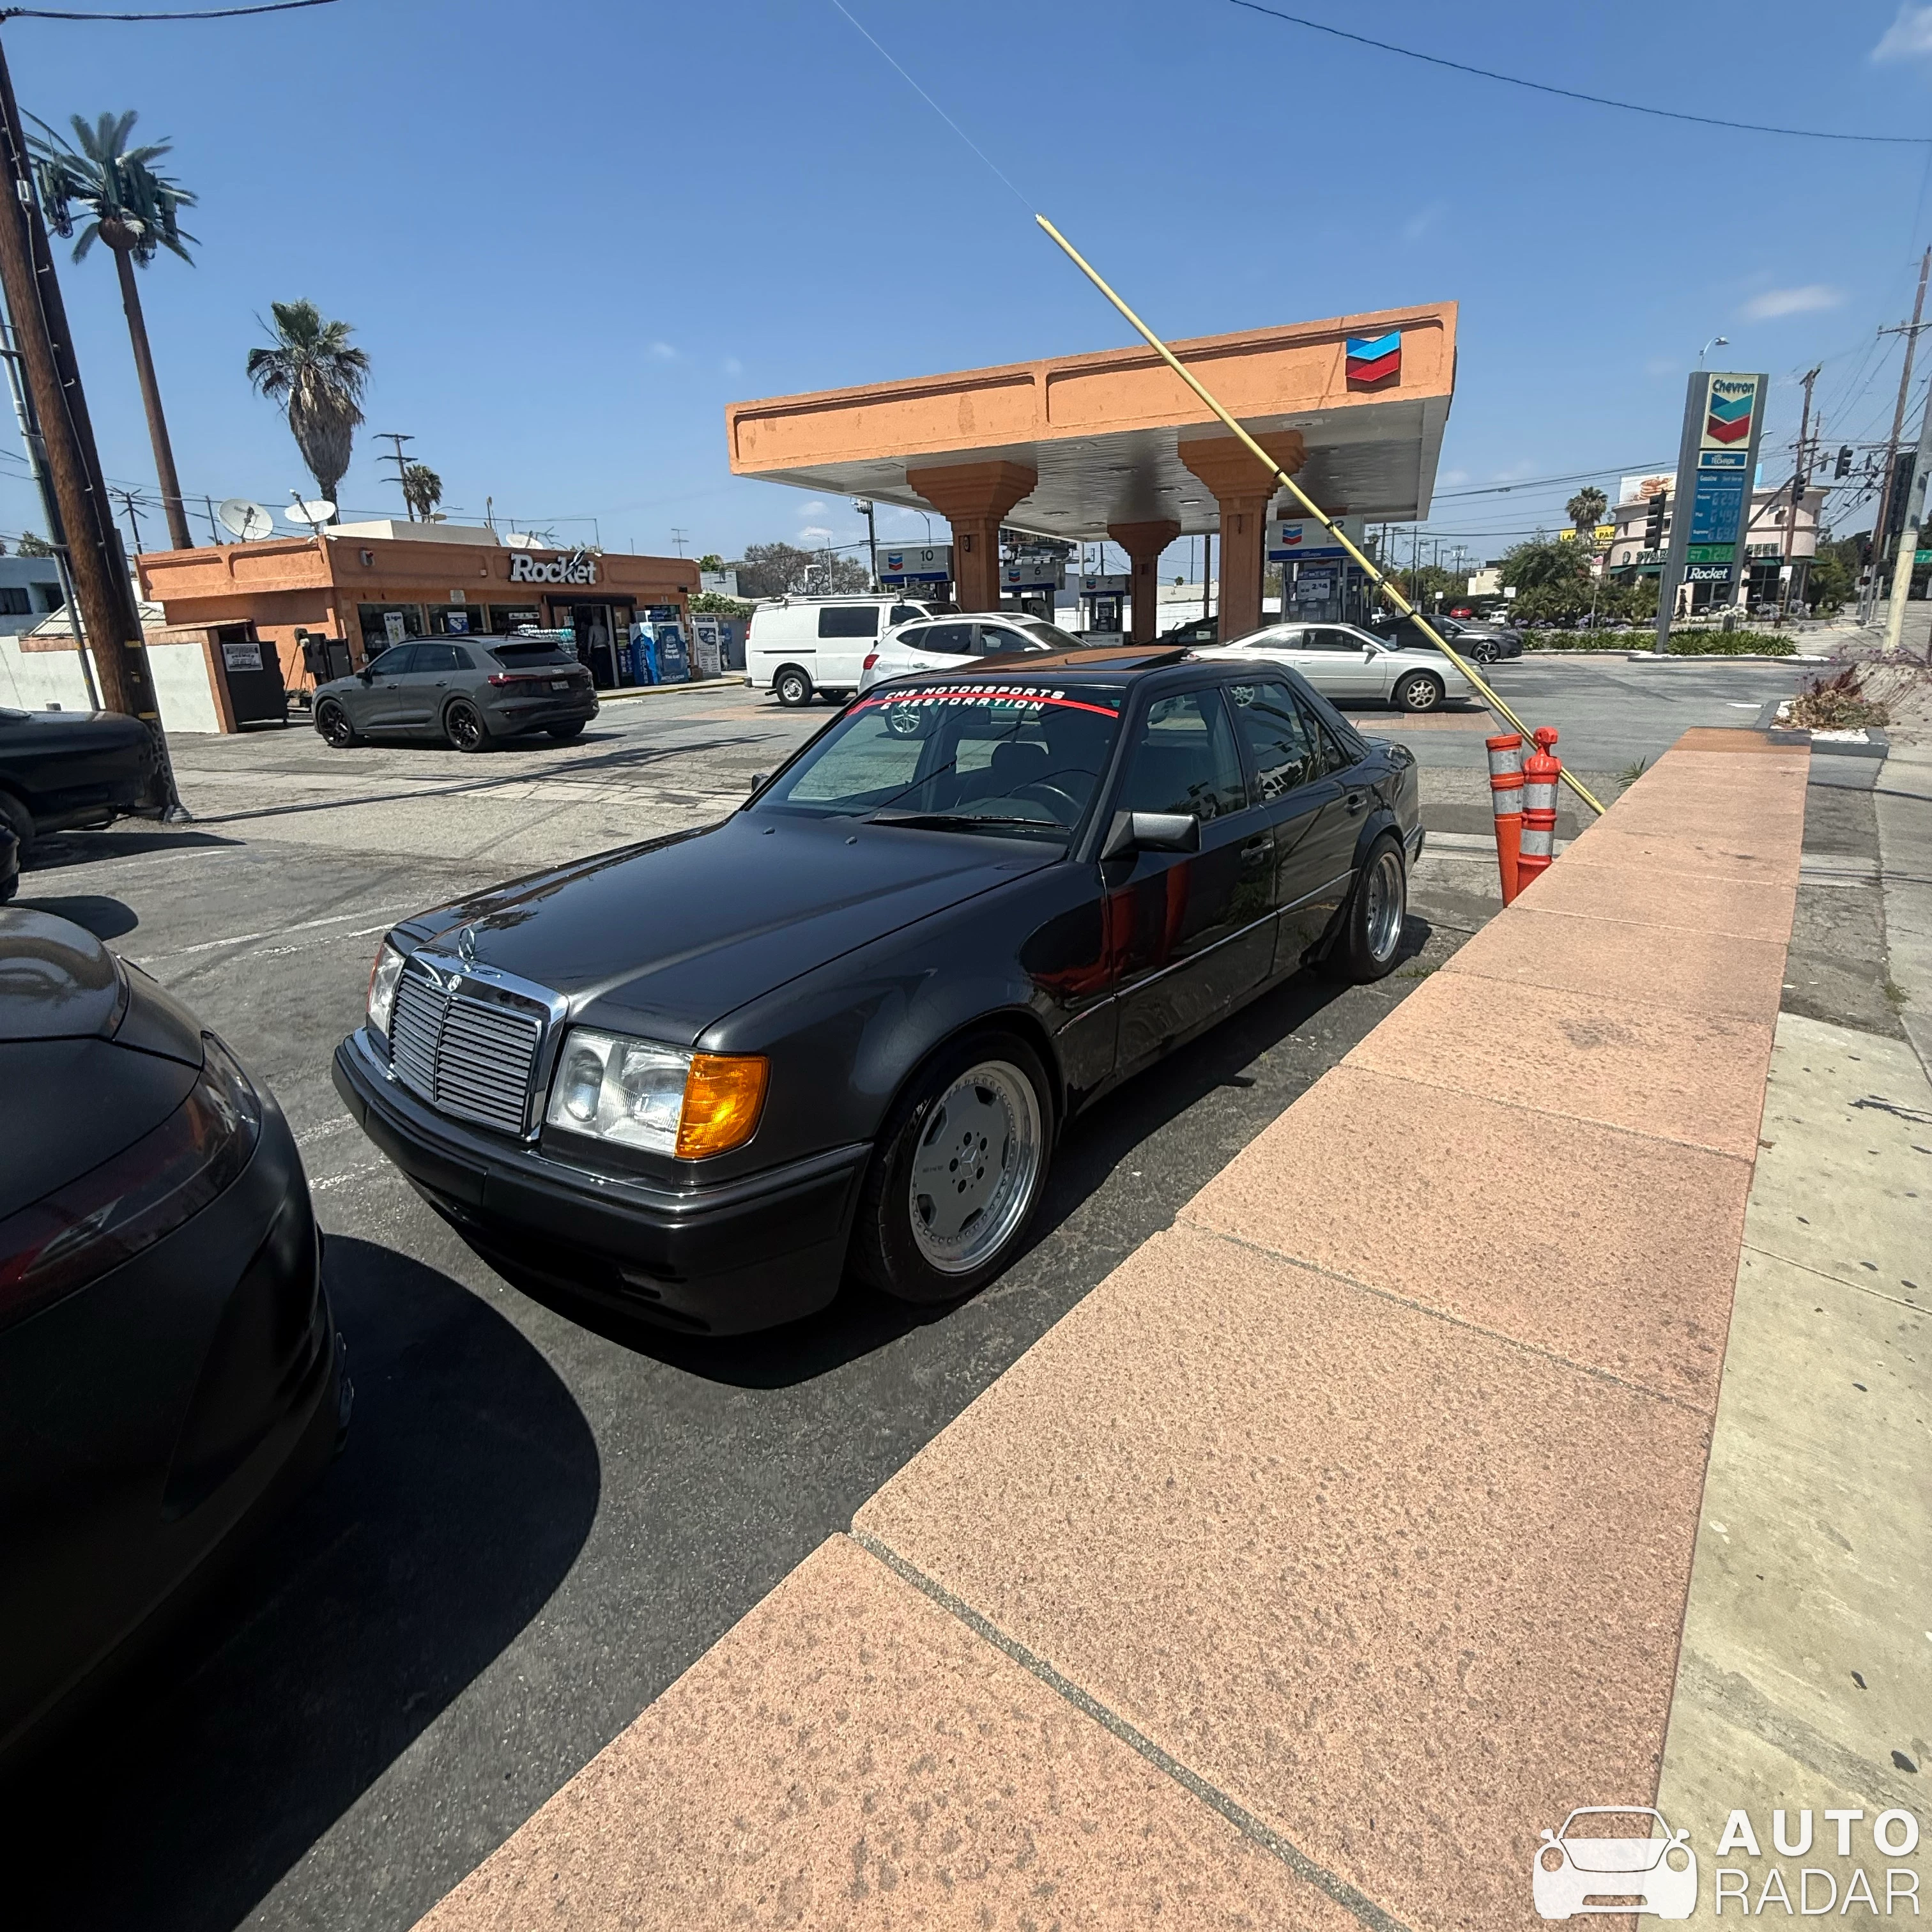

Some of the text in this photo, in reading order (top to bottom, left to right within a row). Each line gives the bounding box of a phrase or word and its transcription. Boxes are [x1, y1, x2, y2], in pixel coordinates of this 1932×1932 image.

[1712, 379, 1754, 394] Chevron
[921, 550, 933, 562] 10
[510, 551, 596, 585] Rocket
[1034, 566, 1041, 575] 6
[1689, 567, 1728, 579] Rocket
[922, 686, 1066, 700] MOTORSPORTS
[898, 697, 1045, 711] RESTORATION
